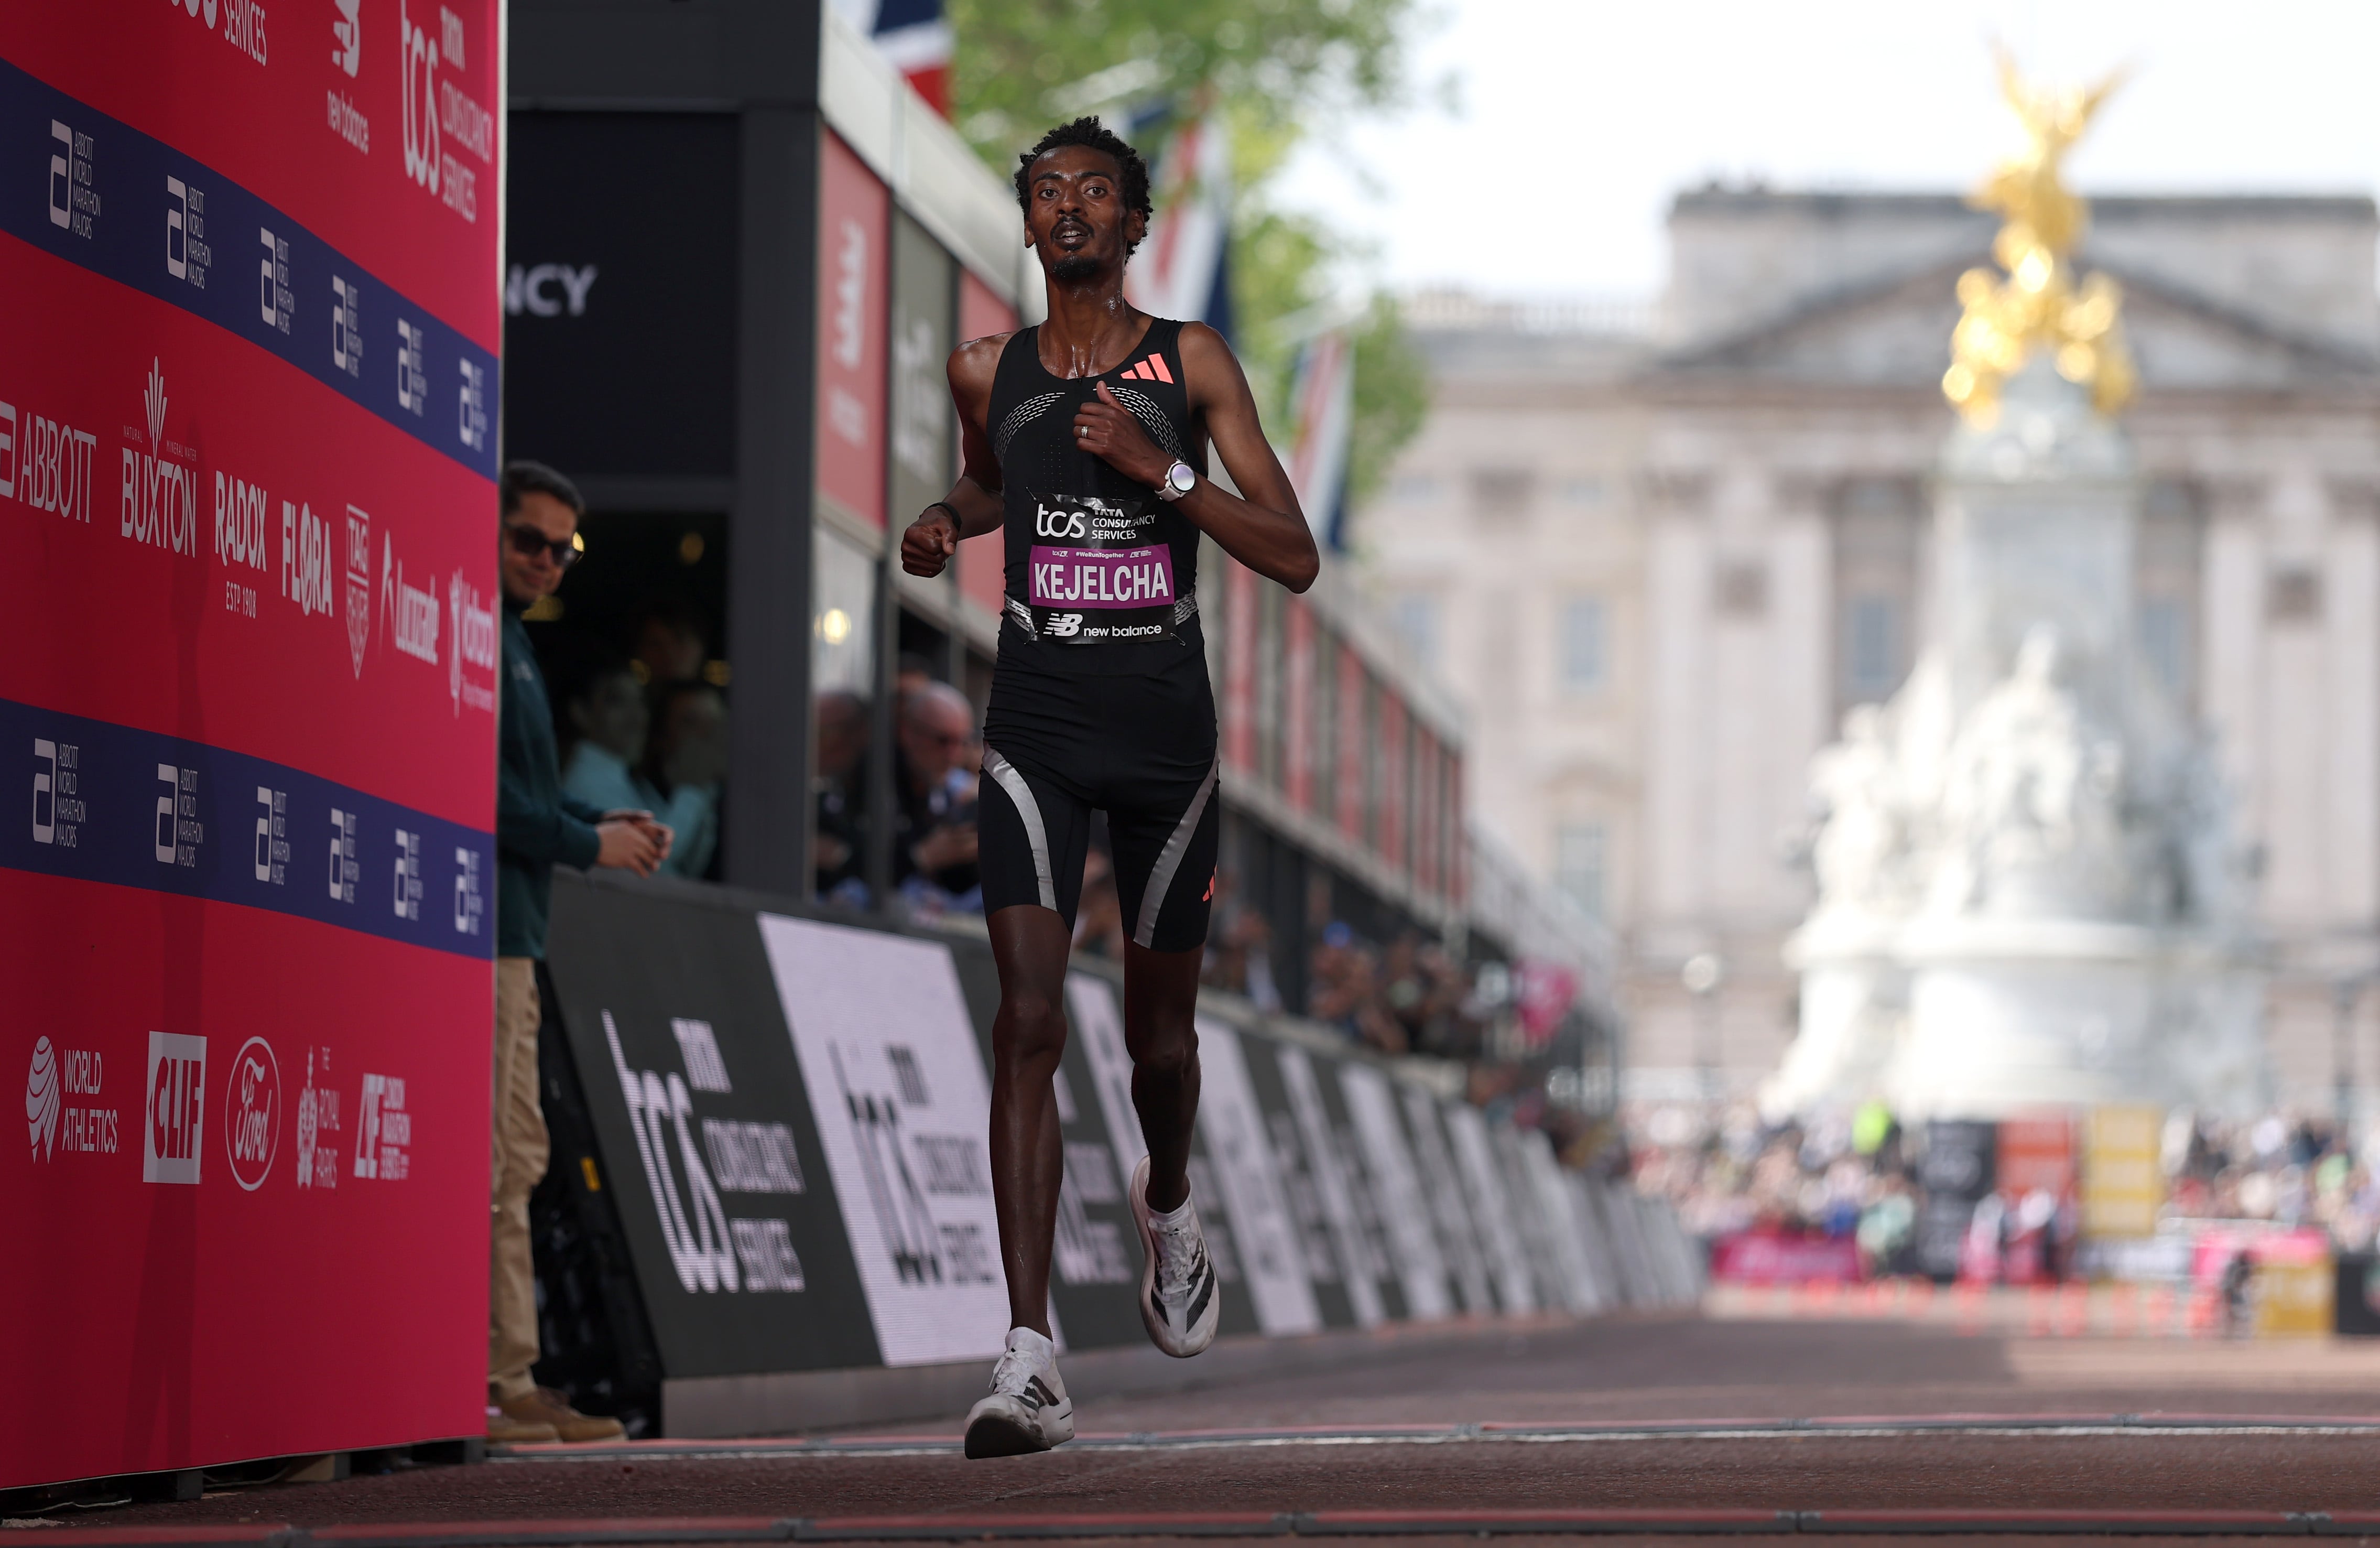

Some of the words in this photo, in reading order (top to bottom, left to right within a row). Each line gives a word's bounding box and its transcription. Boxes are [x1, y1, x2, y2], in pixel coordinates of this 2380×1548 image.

[224, 0, 267, 67] SERVICES
[400, 0, 440, 196] tcs
[74, 131, 93, 160] ABBOTT
[73, 158, 92, 186] WORLD
[73, 184, 101, 217] MARATHON
[188, 186, 204, 214] ABBOTT
[72, 211, 92, 240] MAJORS
[188, 212, 203, 239] WORLD
[188, 237, 211, 268] MARATHON
[188, 262, 205, 289] MAJORS
[123, 425, 143, 443] NATURAL
[166, 440, 183, 458] MINERAL
[184, 446, 197, 462] WATER
[19, 412, 96, 523] ABBOTT
[122, 447, 196, 558] BUXTON
[215, 470, 267, 572] RADOX
[1036, 503, 1085, 538] tcs
[1092, 529, 1136, 540] SERVICES
[282, 500, 333, 618] FLORA
[349, 516, 367, 573] TAG
[1035, 562, 1169, 601] KEJELCHA
[243, 587, 256, 619] 1908
[1083, 627, 1109, 637] new
[1112, 624, 1162, 637] balance
[58, 743, 79, 770] ABBOTT
[58, 770, 77, 795] WORLD
[180, 768, 198, 793] ABBOTT
[57, 796, 86, 823] MARATHON
[179, 794, 196, 817] WORLD
[56, 823, 77, 848] MAJORS
[178, 819, 203, 844] MARATHON
[177, 845, 195, 868] MAJORS
[64, 1049, 102, 1095] WORLD
[153, 1056, 202, 1160] CLIF
[235, 1057, 273, 1163] Ford
[62, 1108, 118, 1154] ATHLETICS
